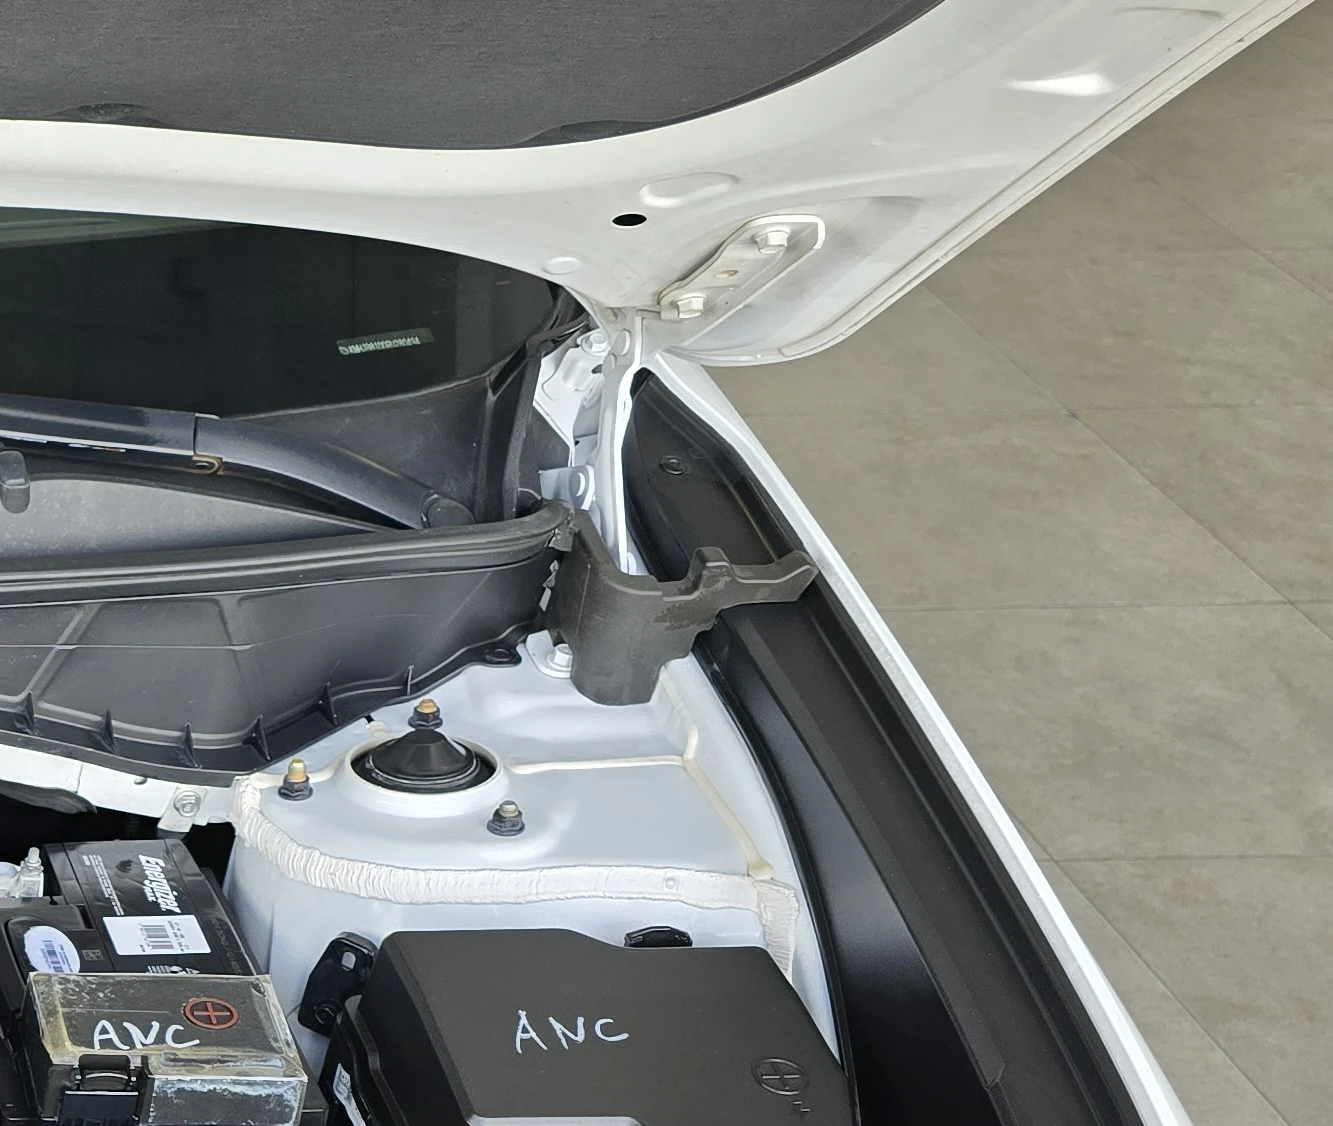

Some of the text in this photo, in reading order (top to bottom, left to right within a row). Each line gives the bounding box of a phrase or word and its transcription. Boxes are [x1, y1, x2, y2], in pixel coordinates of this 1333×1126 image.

[138, 854, 182, 914] Energizer
[93, 1019, 201, 1051] ANC
[515, 1009, 630, 1054] ANC
